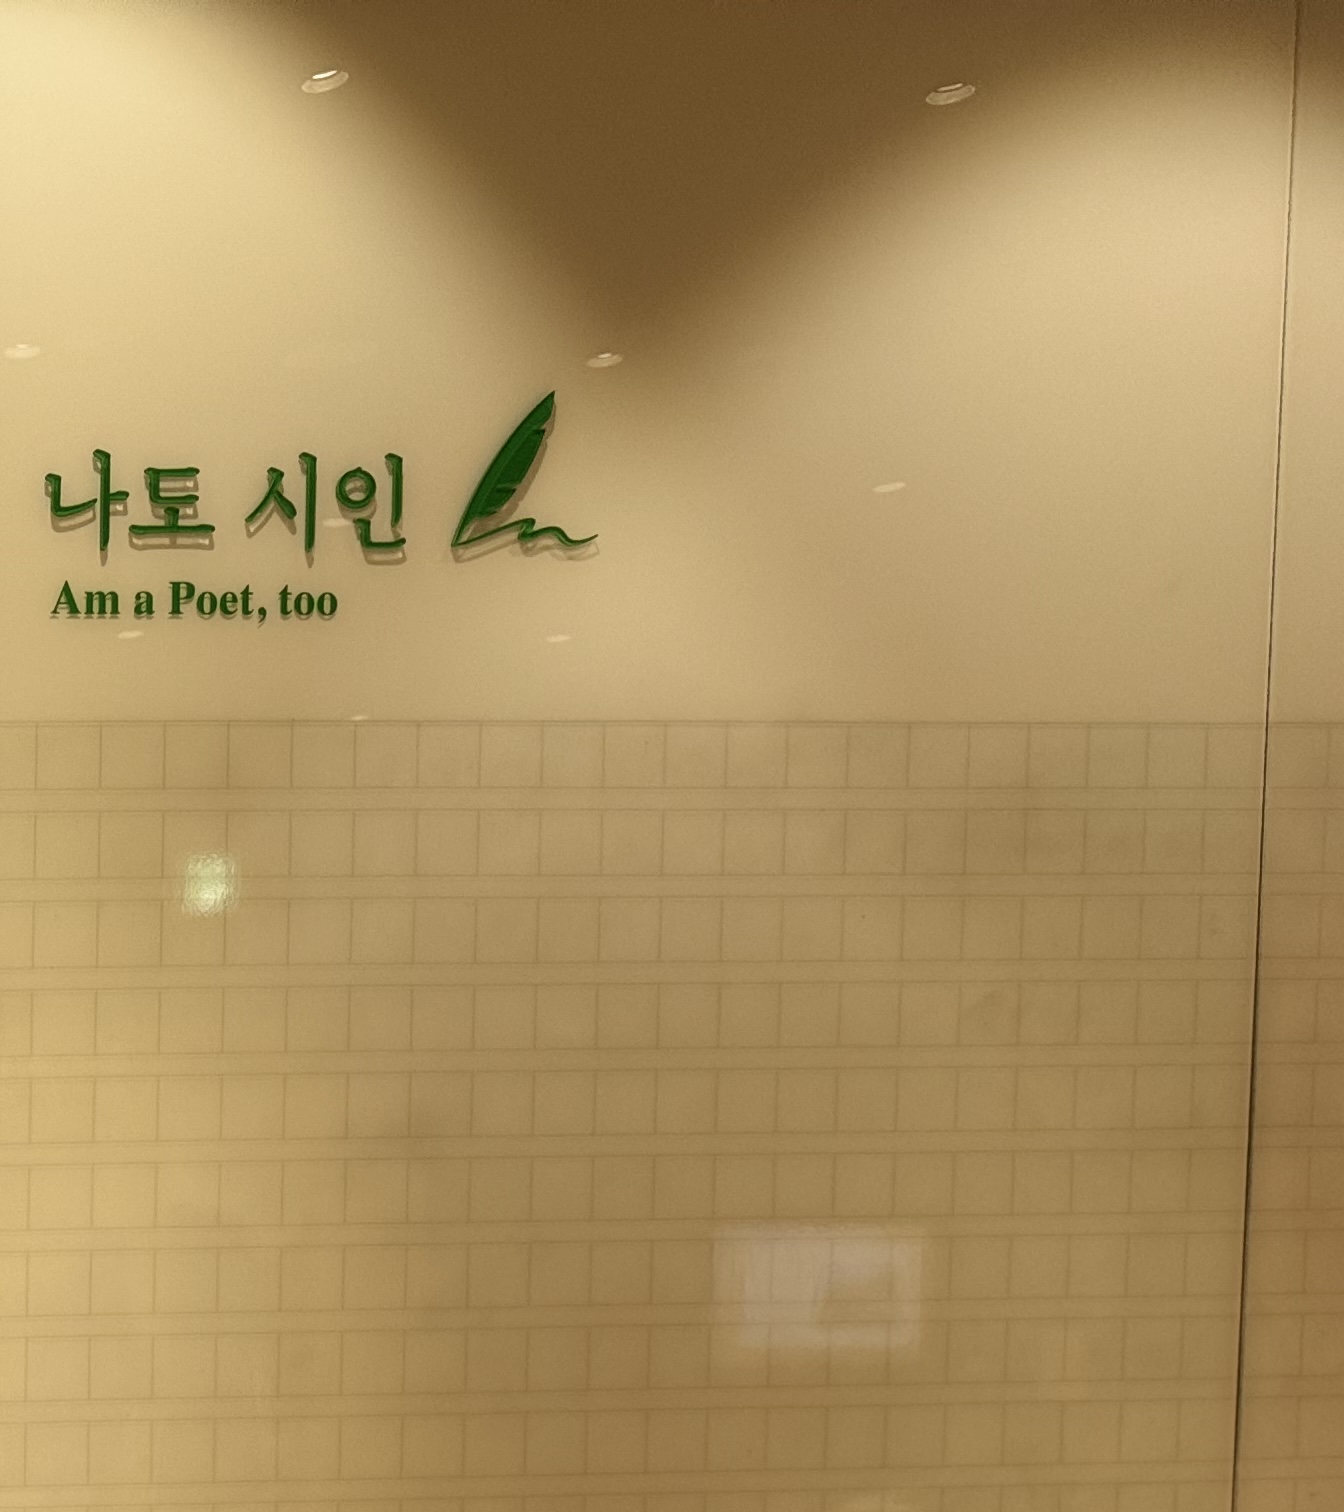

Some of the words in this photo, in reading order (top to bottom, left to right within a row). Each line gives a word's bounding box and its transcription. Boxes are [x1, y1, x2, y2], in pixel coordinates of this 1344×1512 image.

[44, 449, 215, 552] 나도
[244, 451, 406, 553] 시인
[50, 580, 120, 617] Am
[134, 590, 156, 617] a
[168, 581, 268, 625] Poet,
[279, 585, 339, 617] too
